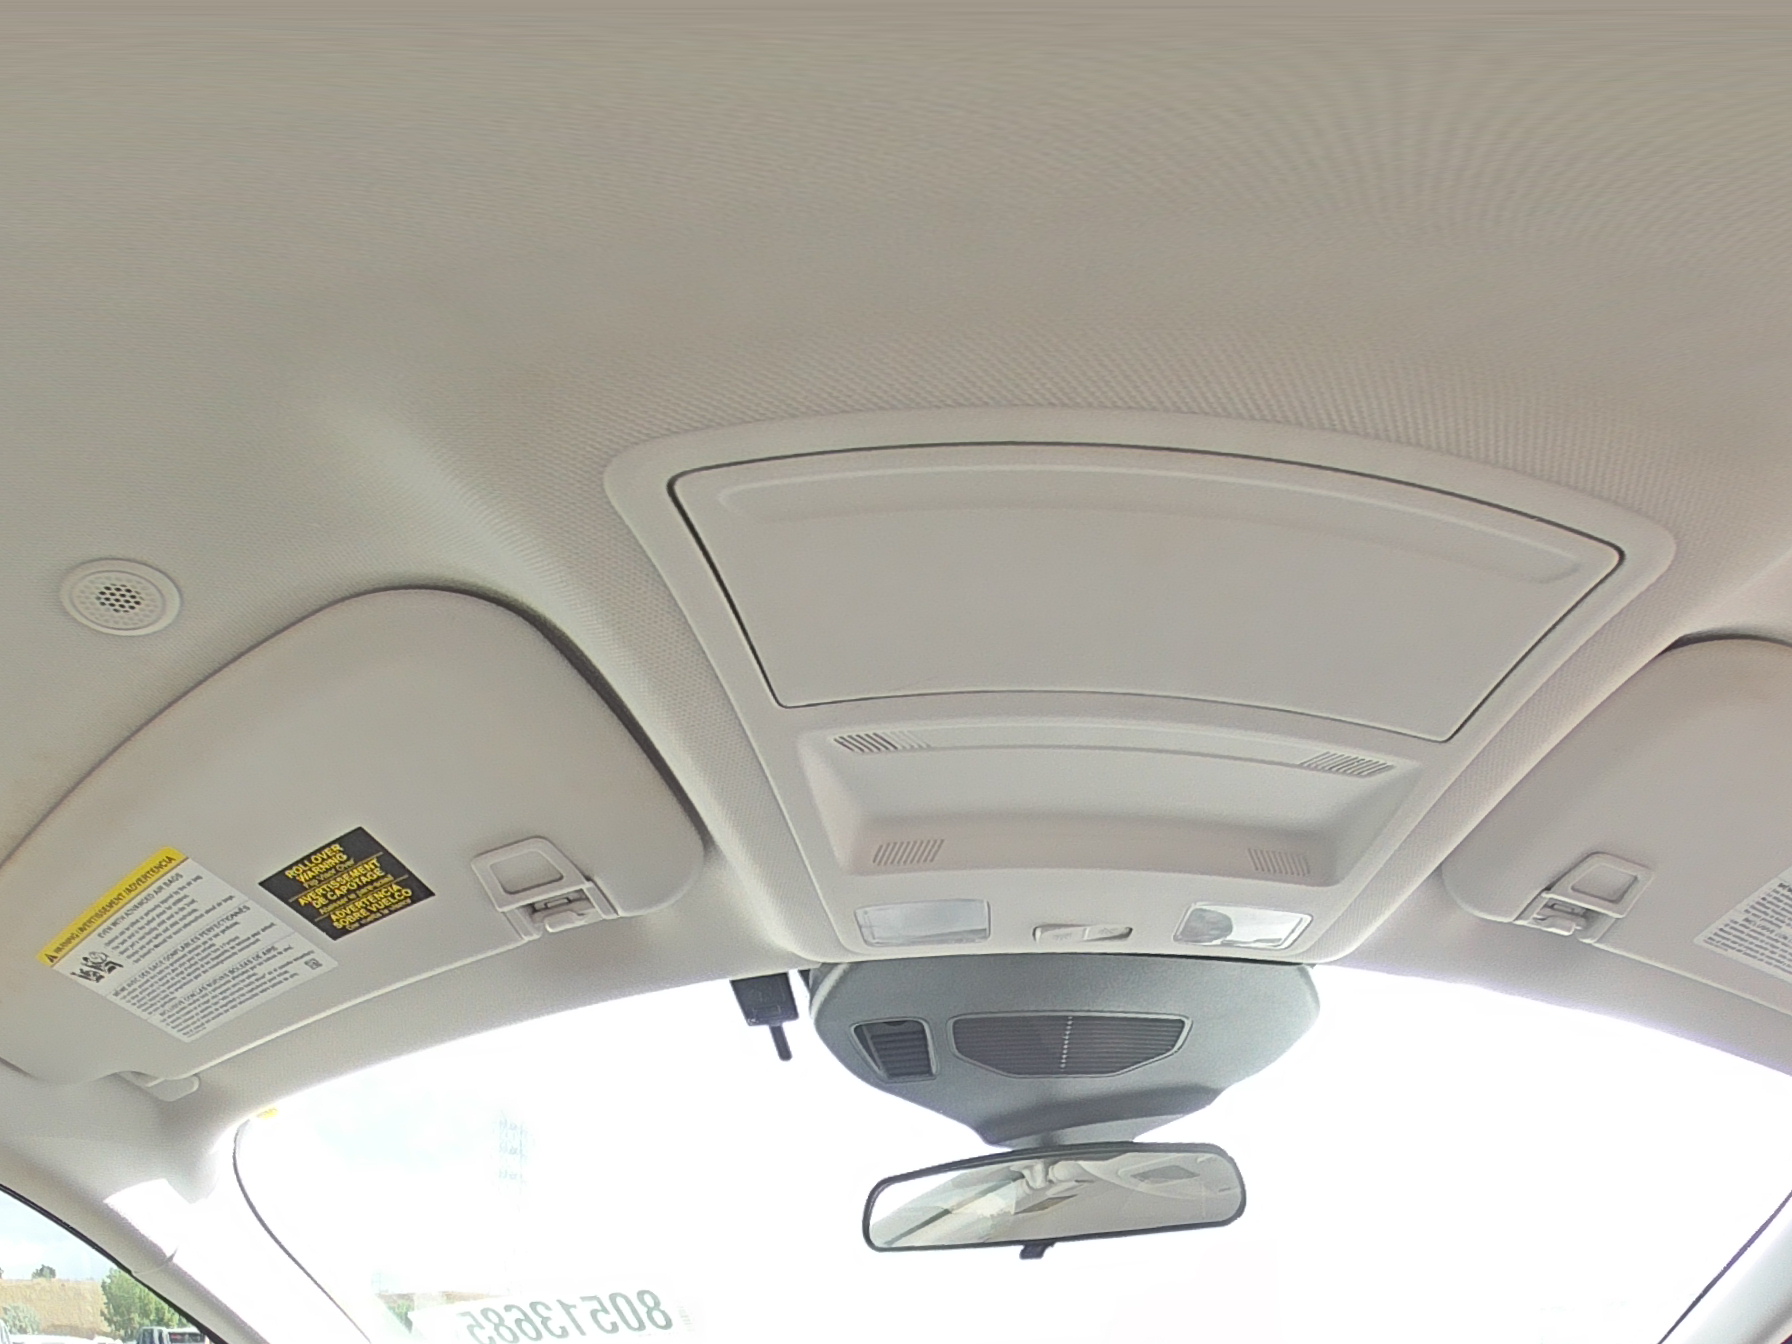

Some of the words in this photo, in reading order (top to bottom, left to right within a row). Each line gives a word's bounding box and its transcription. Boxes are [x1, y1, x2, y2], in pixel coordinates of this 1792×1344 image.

[285, 843, 344, 879] ROLLOVER
[296, 853, 348, 883] WARNING
[336, 858, 355, 872] Over
[297, 858, 381, 907] AVERTISSEMENT
[312, 895, 329, 909] DE
[327, 867, 385, 900] CAPOTAGE
[329, 883, 403, 922] ADVERTENCIA
[95, 925, 114, 938] EVEN
[122, 892, 157, 918] ADVANCED
[161, 871, 184, 888] BAGS
[332, 907, 370, 930] SOBRE
[368, 888, 412, 913] VUELCO
